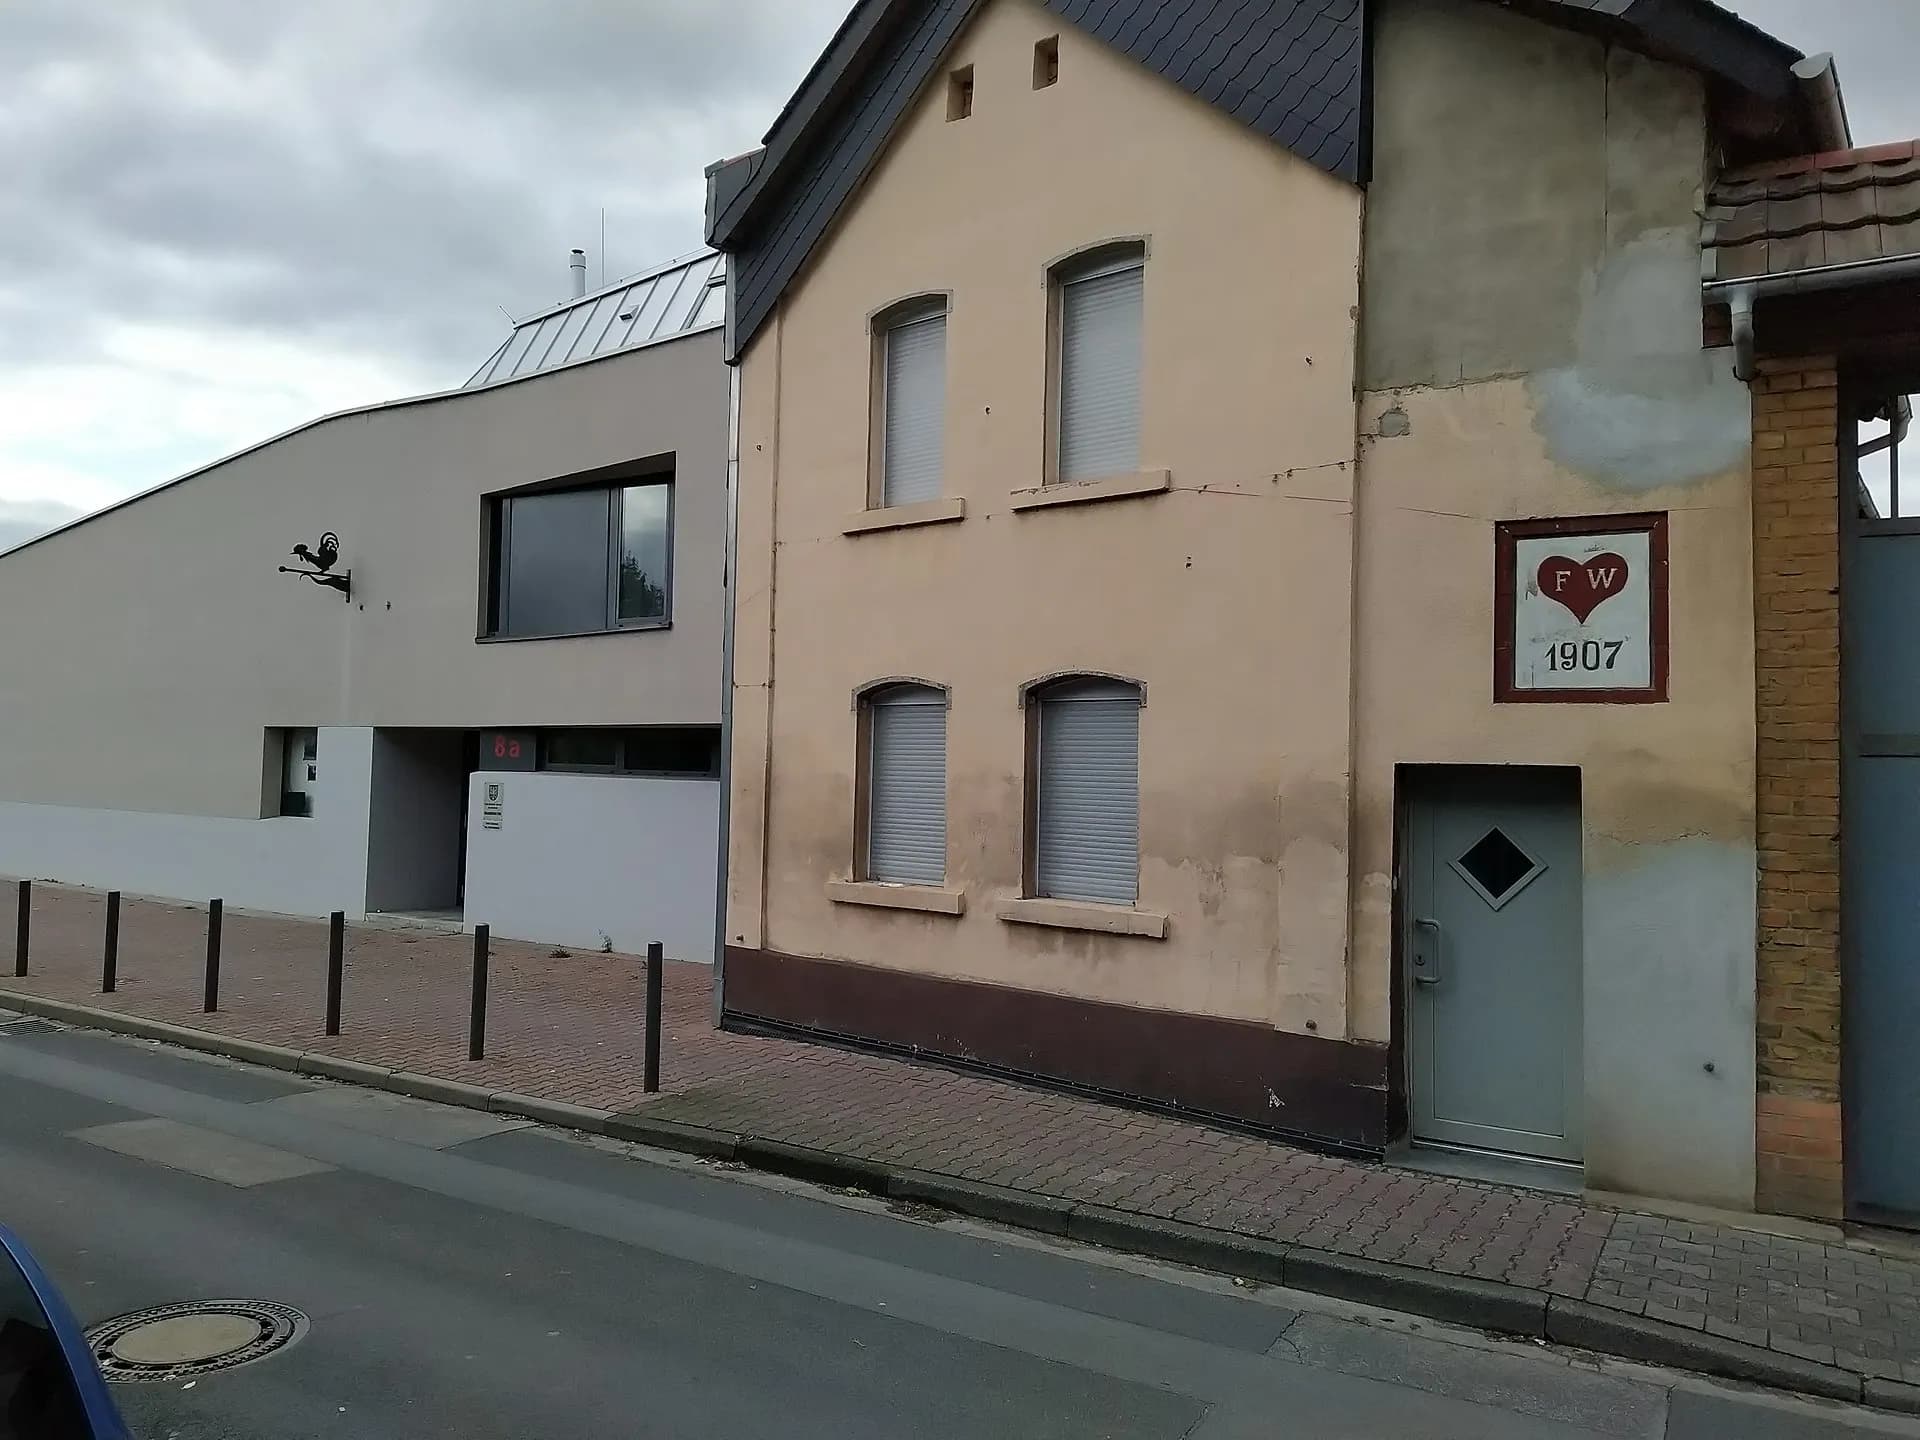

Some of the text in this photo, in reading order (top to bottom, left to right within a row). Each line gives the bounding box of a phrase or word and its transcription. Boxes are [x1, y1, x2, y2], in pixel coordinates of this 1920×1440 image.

[1554, 567, 1619, 592] F W
[1544, 640, 1624, 671] 1907
[494, 735, 521, 758] 8a
